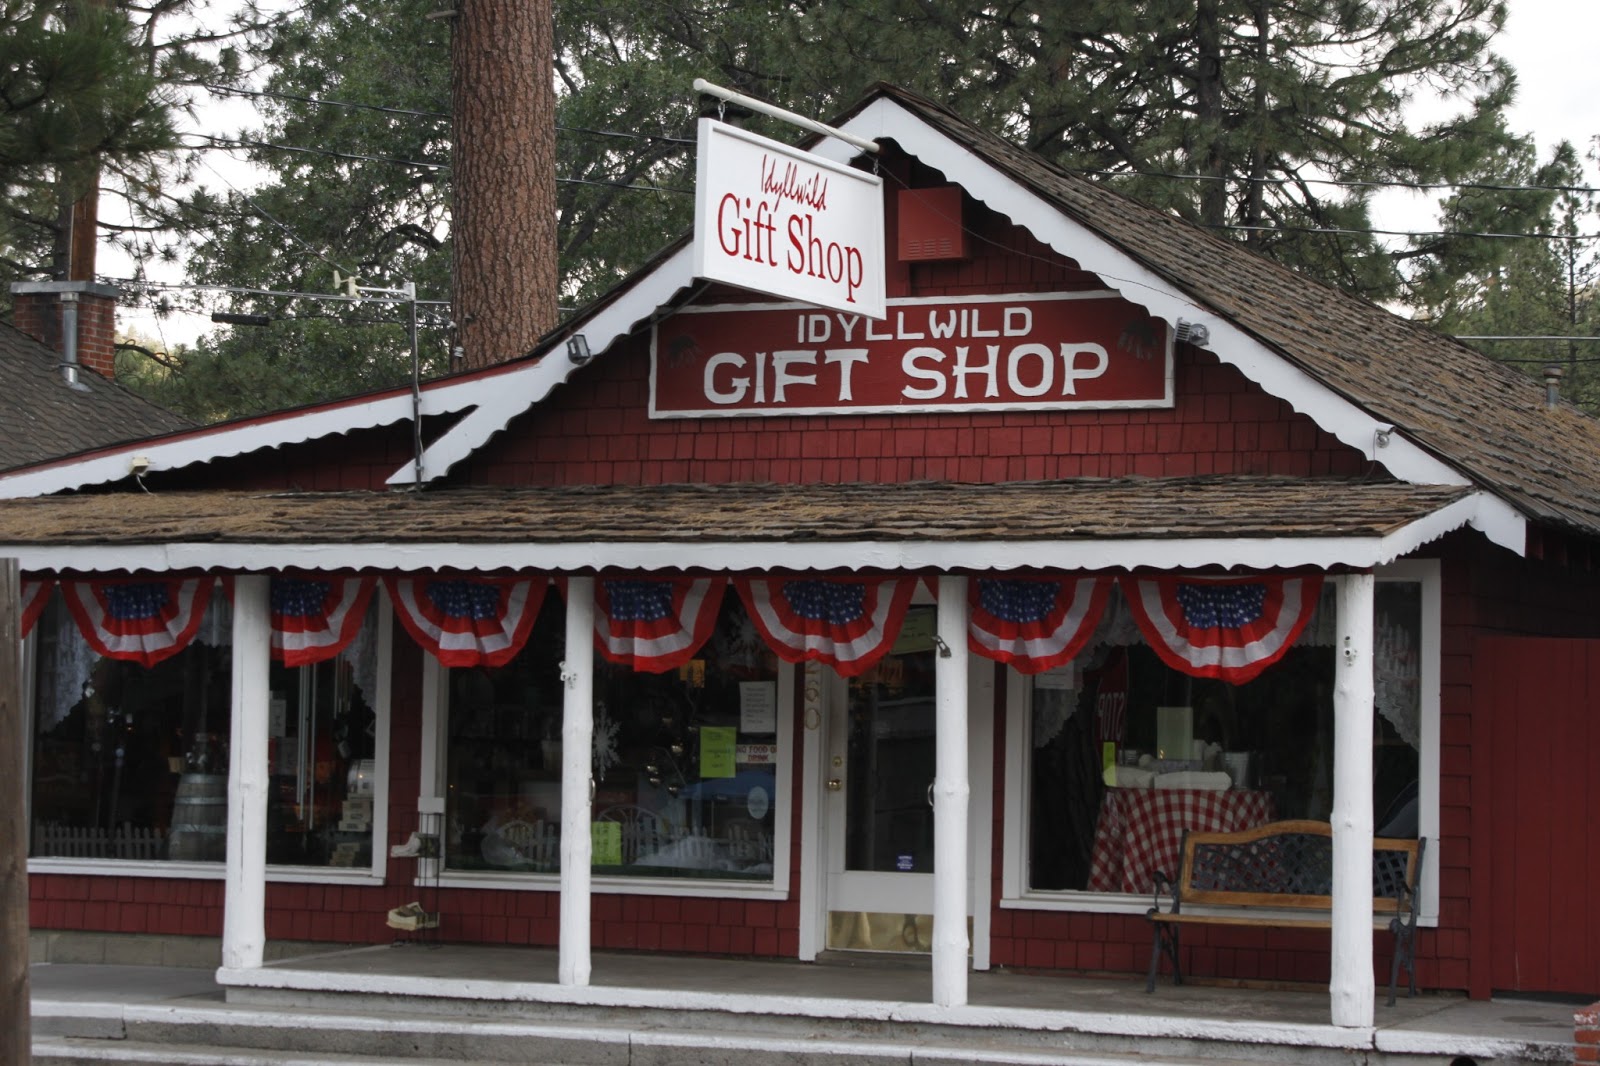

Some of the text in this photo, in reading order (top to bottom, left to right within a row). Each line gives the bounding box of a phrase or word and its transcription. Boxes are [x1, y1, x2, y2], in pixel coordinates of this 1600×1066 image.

[761, 154, 828, 212] Idyllwild
[717, 192, 863, 304] Gift Shop
[797, 306, 1033, 344] IDYLLWILD
[703, 341, 1110, 405] GIFT SHOP
[749, 745, 769, 753] FOOD
